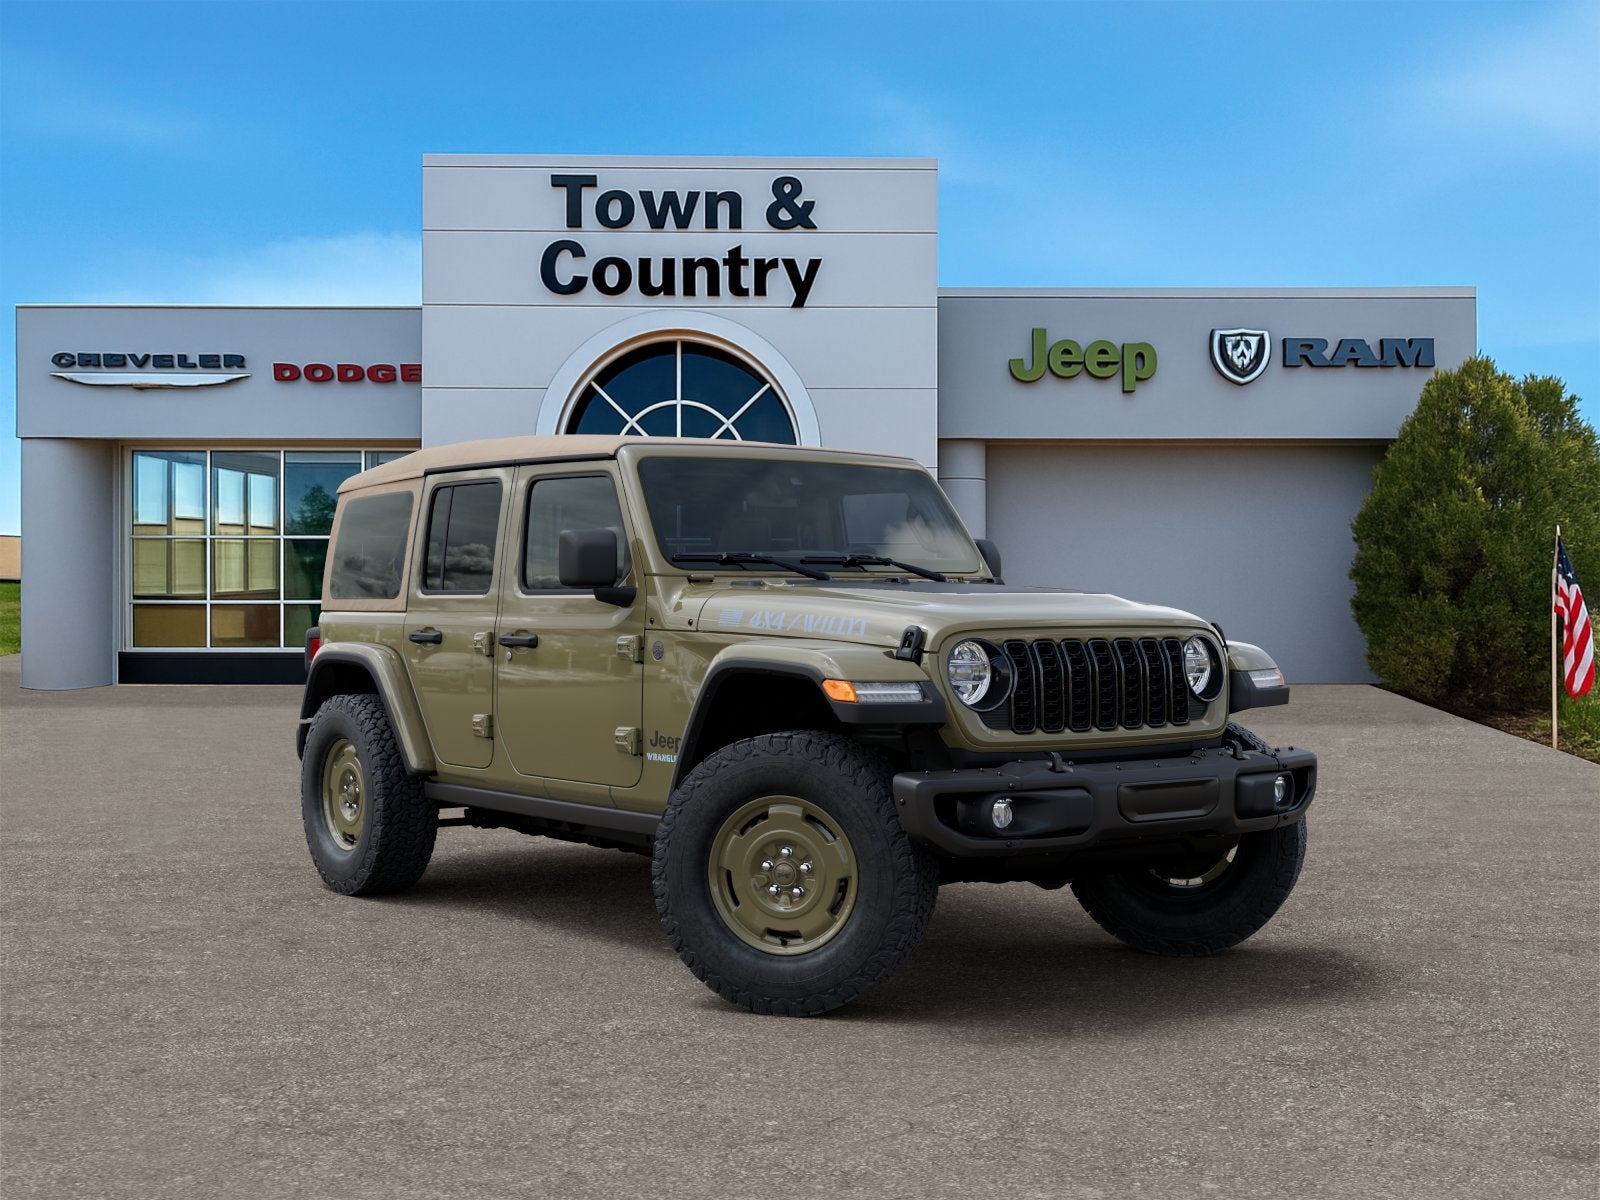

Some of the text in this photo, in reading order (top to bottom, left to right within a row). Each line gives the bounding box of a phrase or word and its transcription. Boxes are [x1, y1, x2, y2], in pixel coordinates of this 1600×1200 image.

[550, 174, 818, 230] Town &
[540, 239, 822, 308] Country
[272, 363, 422, 383] DODGE
[1008, 328, 1157, 392] Jeep
[1282, 337, 1436, 368] RAM
[646, 752, 677, 763] WRANGLE
